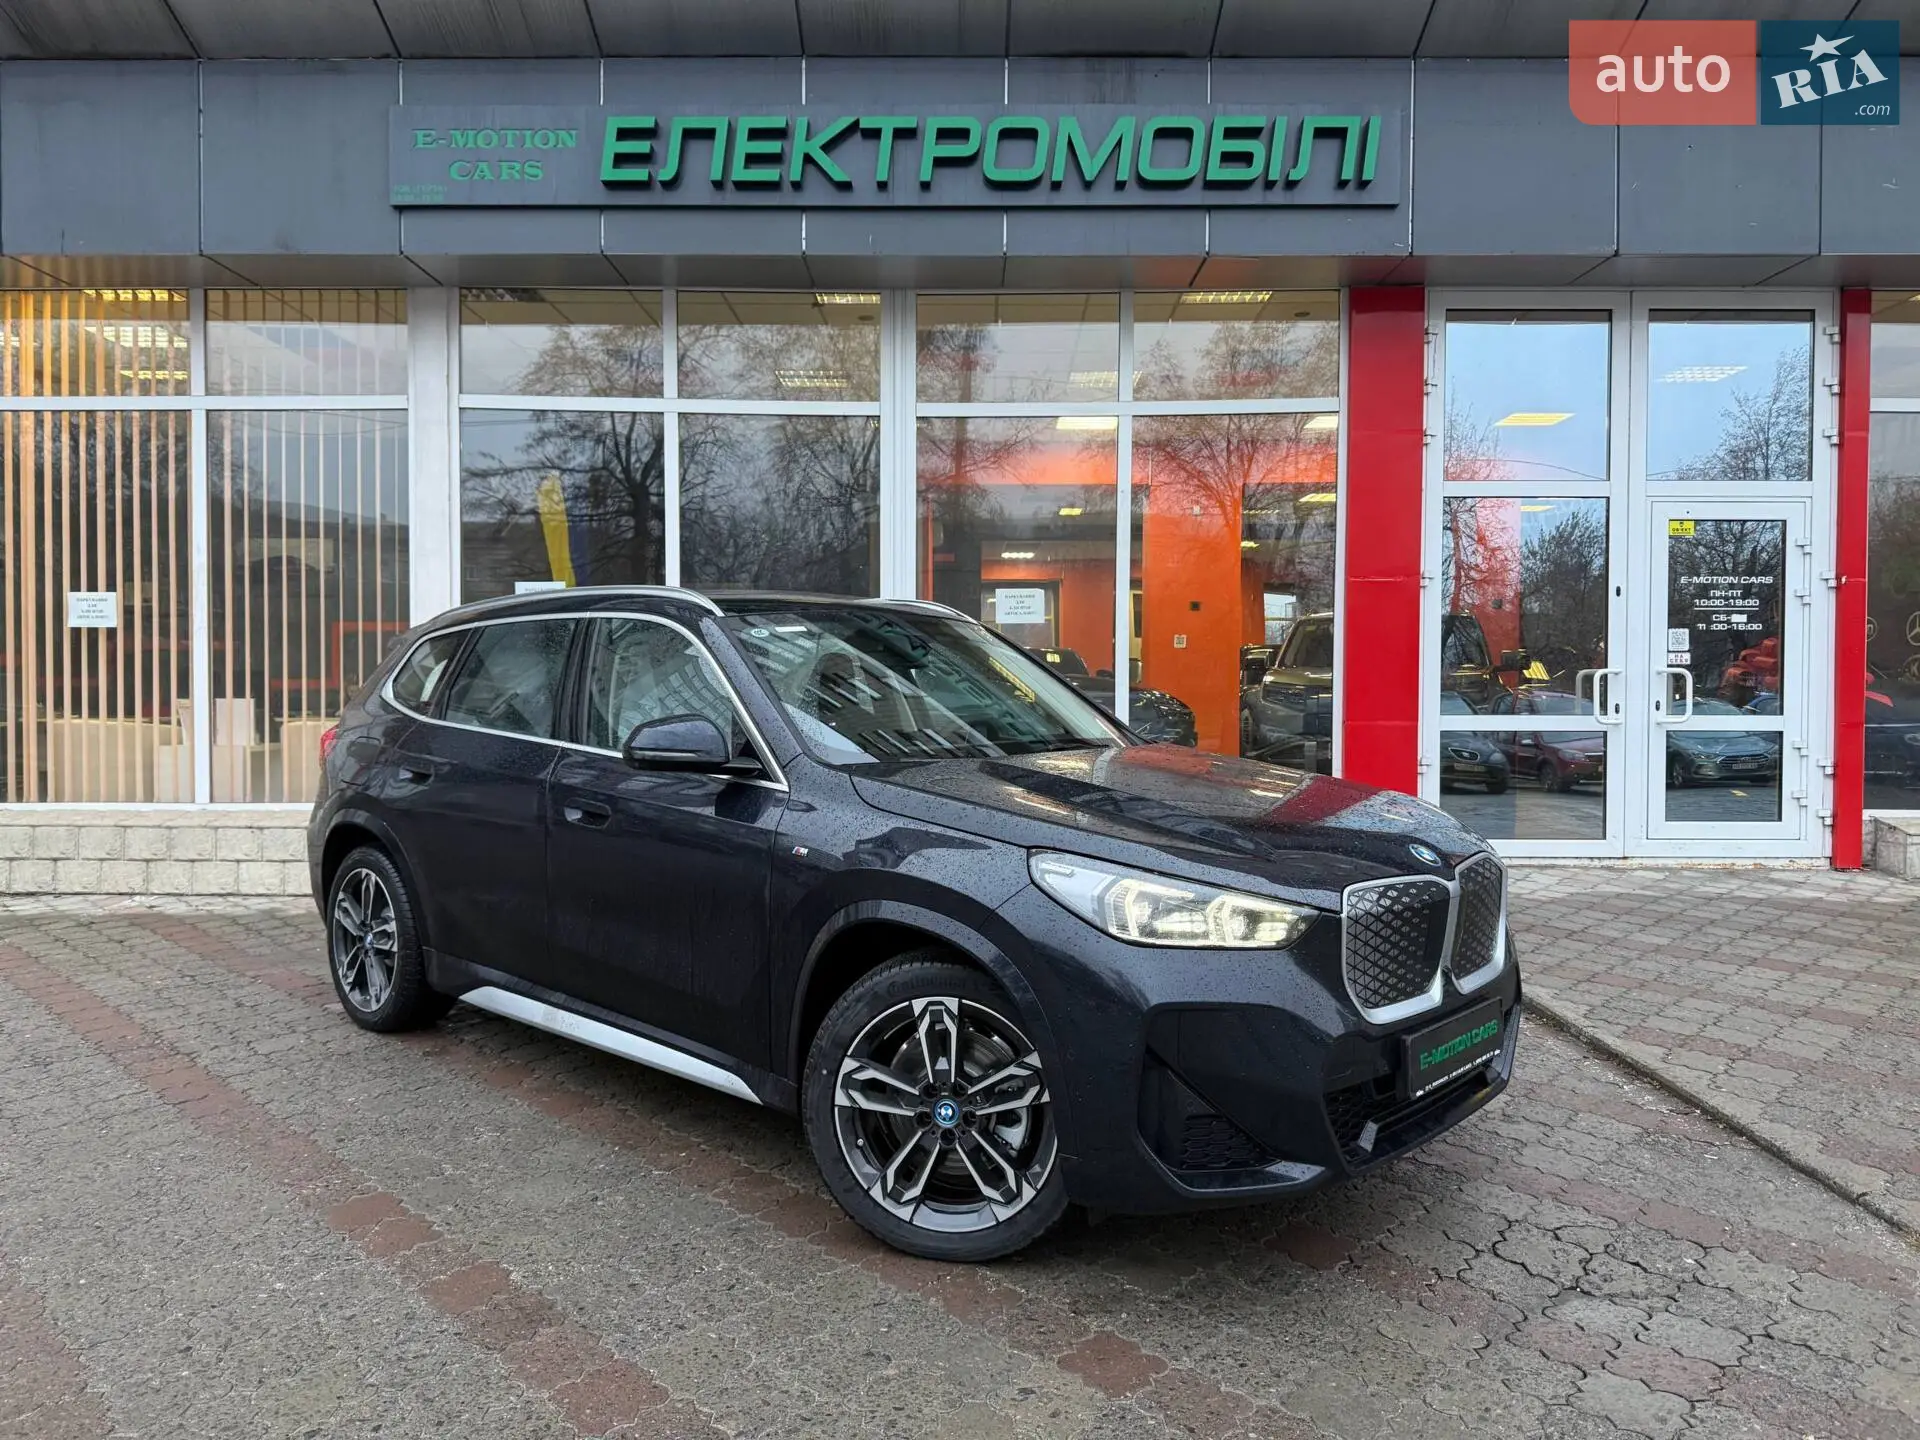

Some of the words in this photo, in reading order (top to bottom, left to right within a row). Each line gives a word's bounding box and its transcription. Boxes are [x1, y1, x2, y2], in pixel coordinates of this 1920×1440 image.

[412, 129, 579, 149] E-MOTION
[600, 115, 1382, 189] ЕЛЕКТРОМОБІЛІ
[449, 160, 545, 181] CARS
[1680, 576, 1739, 584] E-MOTION
[1740, 576, 1774, 584] CARS
[1420, 1032, 1471, 1071] E-MOTION
[1472, 1019, 1498, 1042] CARS
